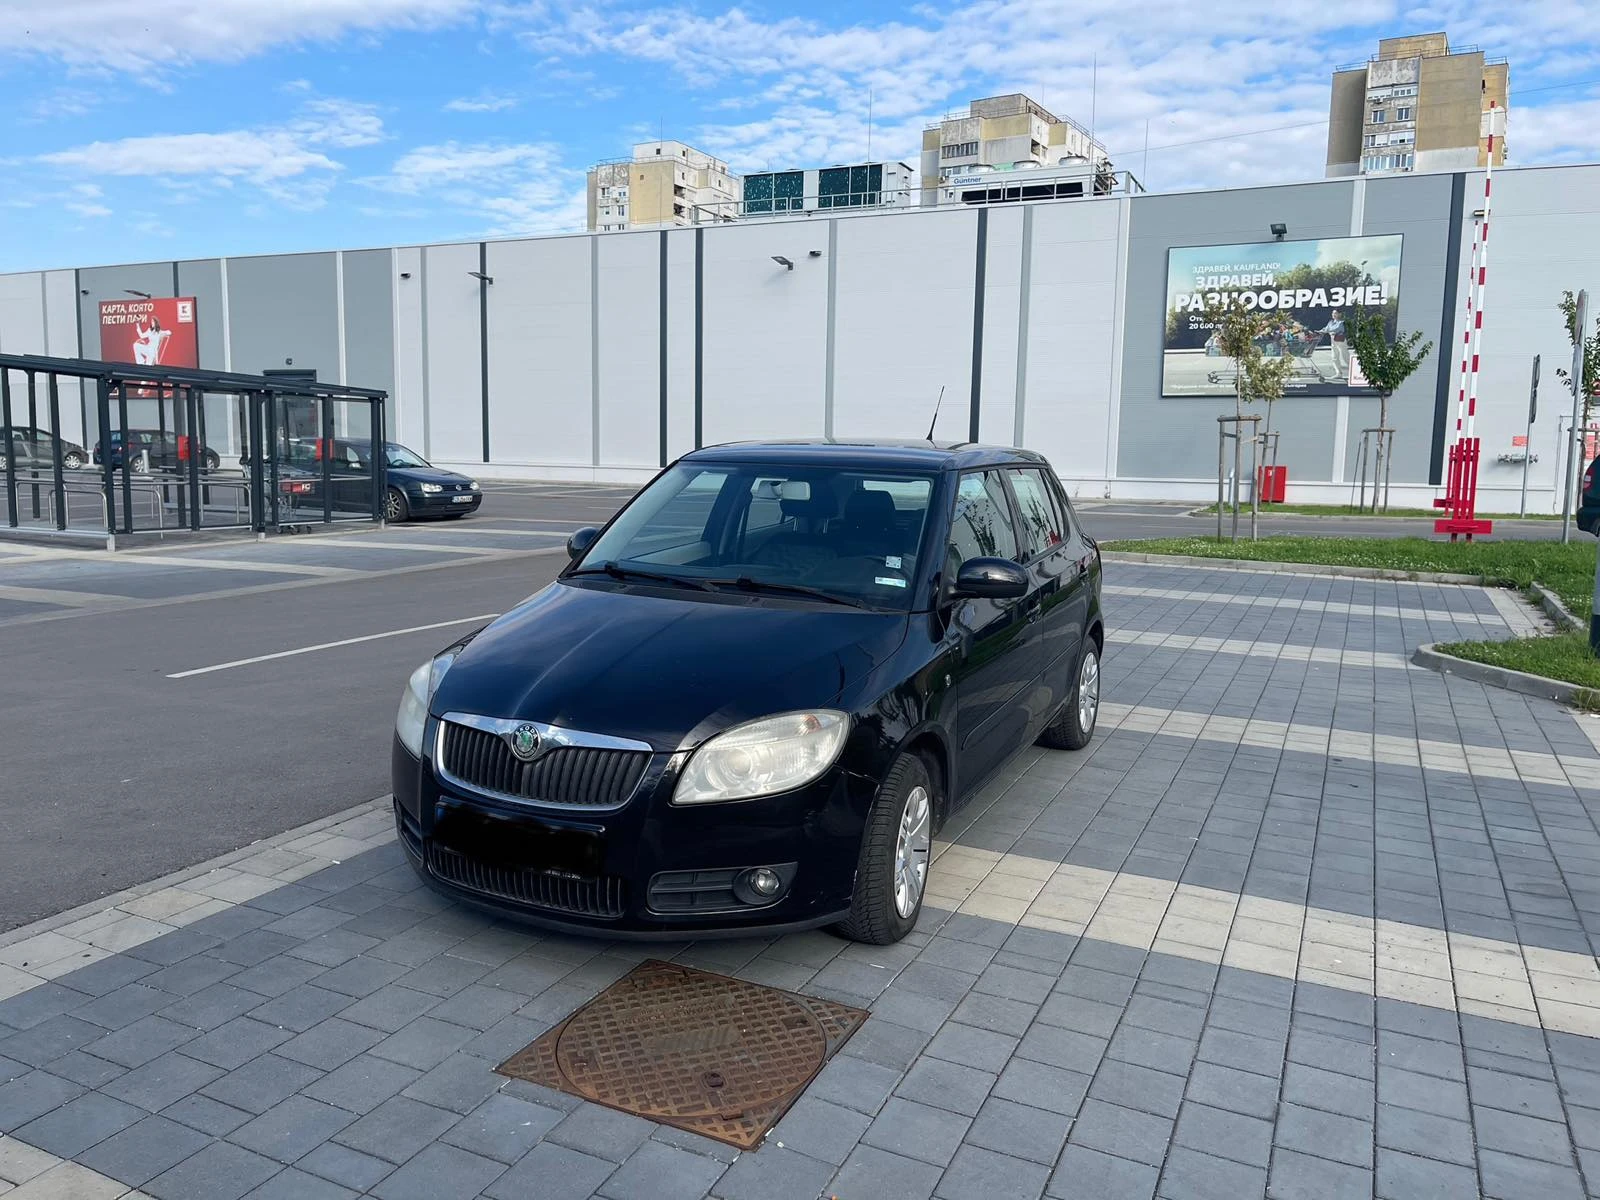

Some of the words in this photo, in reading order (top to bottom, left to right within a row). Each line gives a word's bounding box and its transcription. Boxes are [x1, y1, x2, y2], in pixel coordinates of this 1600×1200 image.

[1233, 262, 1281, 271] KAUFLAND!
[1195, 270, 1277, 291] ЗДРАВЕЙ,
[1175, 281, 1388, 312] РАЗНООБРАЗИЕ!
[102, 304, 127, 314] КАРТА,
[128, 303, 154, 313] КОЯТО
[102, 315, 126, 325] ПЕСТИ
